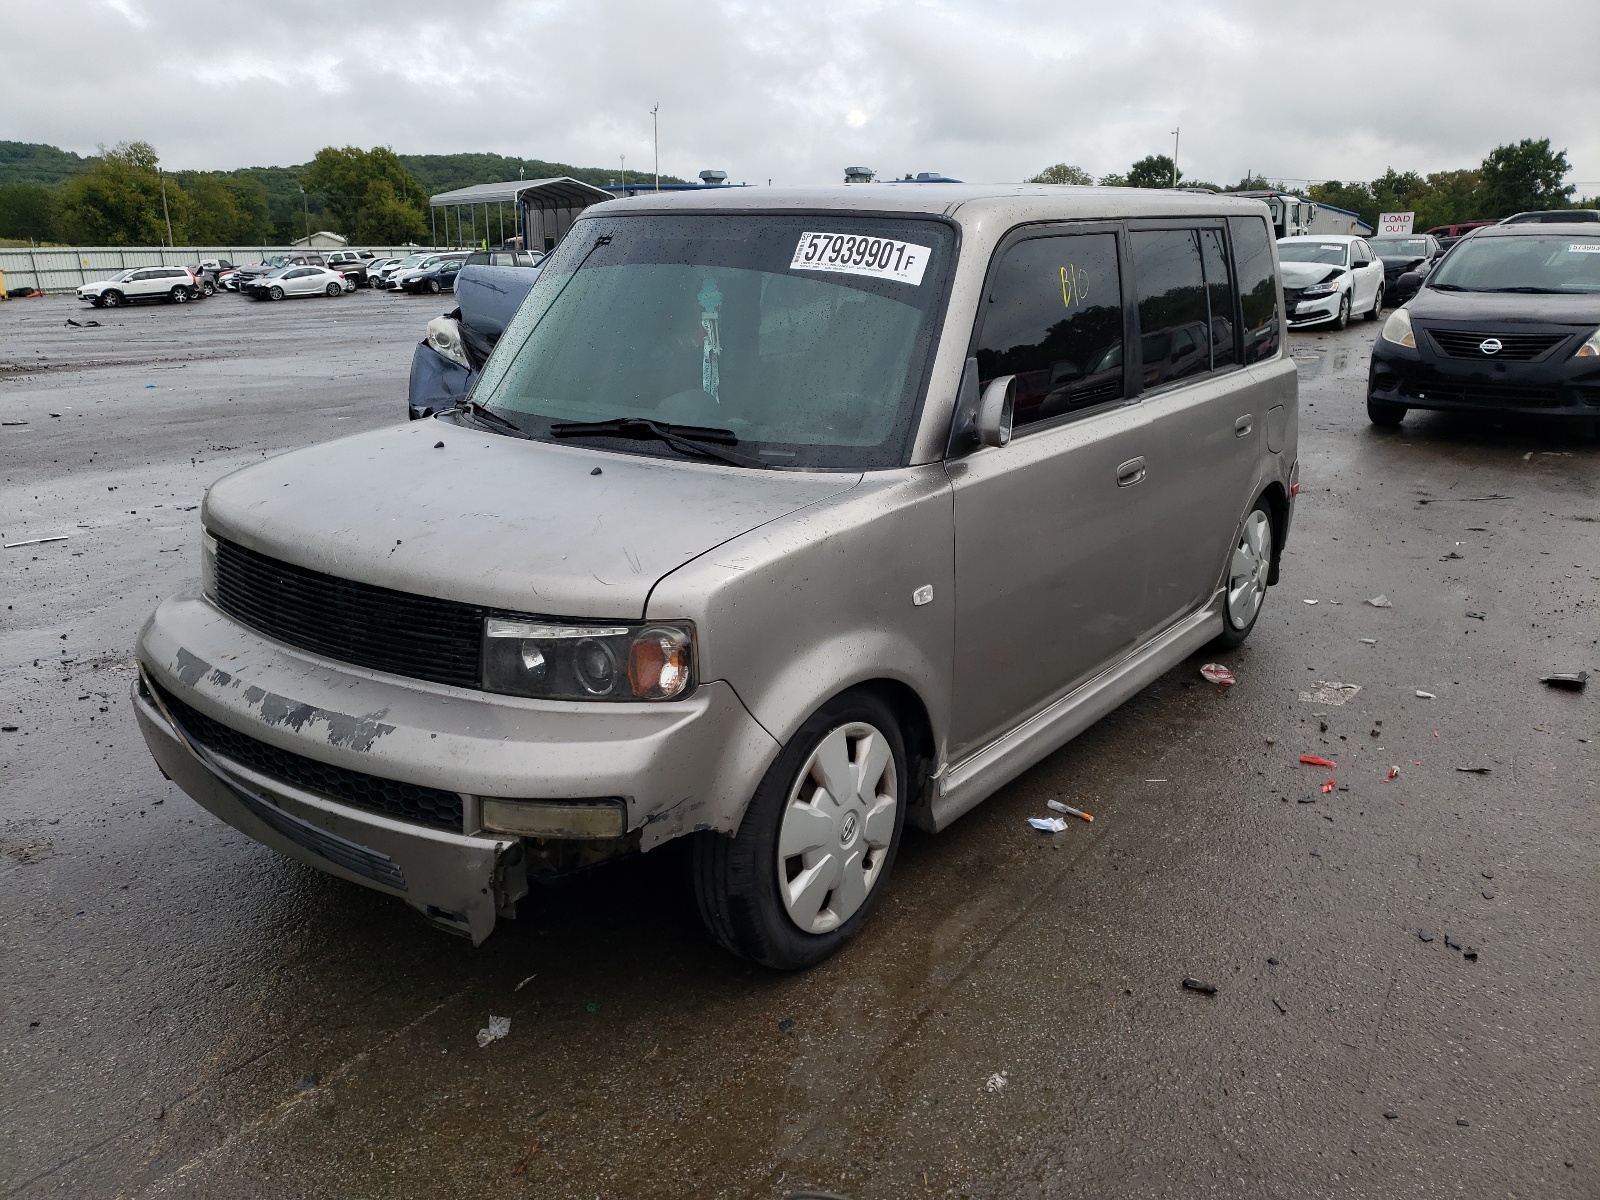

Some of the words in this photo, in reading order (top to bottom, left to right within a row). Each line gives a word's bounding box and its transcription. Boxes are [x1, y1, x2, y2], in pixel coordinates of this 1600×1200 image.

[1383, 215, 1411, 223] LOAD
[804, 234, 906, 271] 57939901
[904, 255, 915, 270] F
